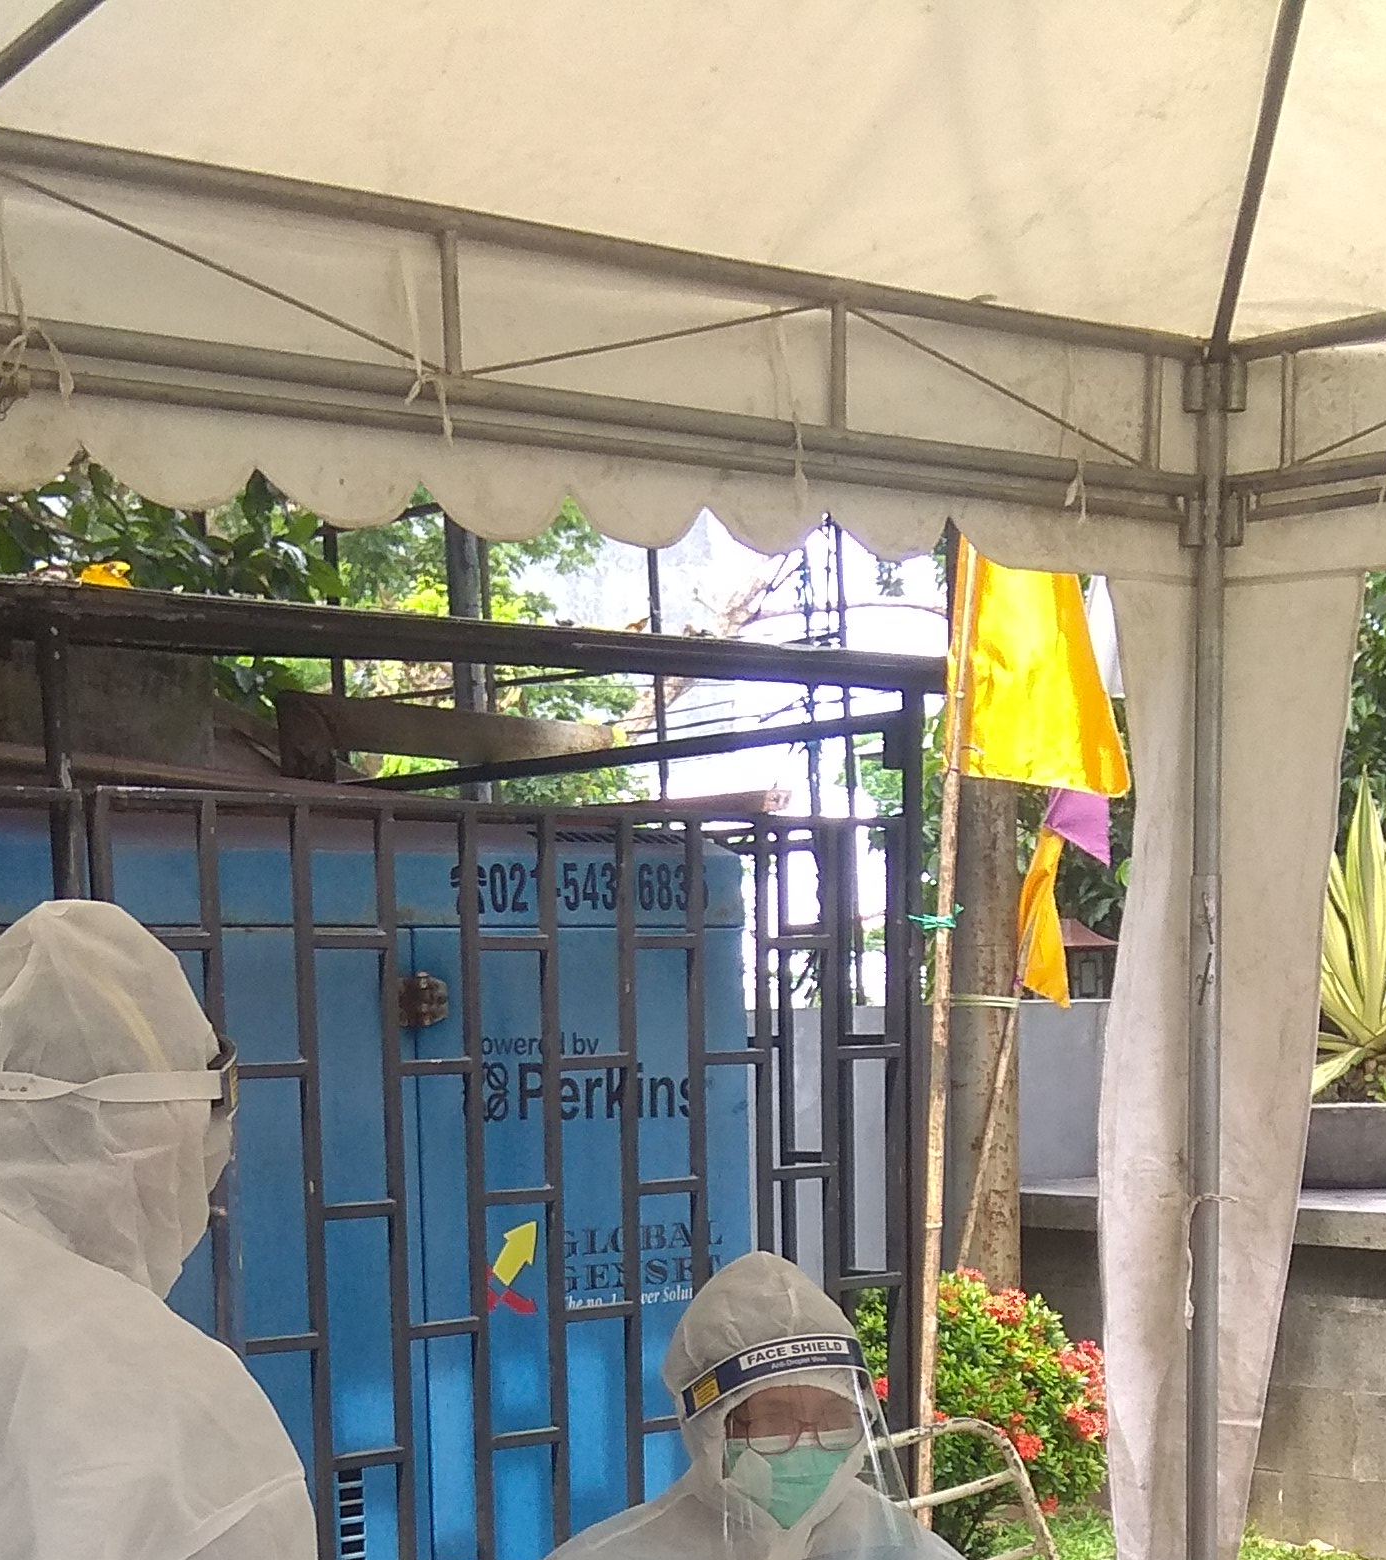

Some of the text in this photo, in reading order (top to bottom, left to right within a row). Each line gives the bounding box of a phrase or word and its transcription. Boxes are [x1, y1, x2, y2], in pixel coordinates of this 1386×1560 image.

[572, 1032, 599, 1055] by
[747, 1341, 842, 1366] FACE SHIELD
